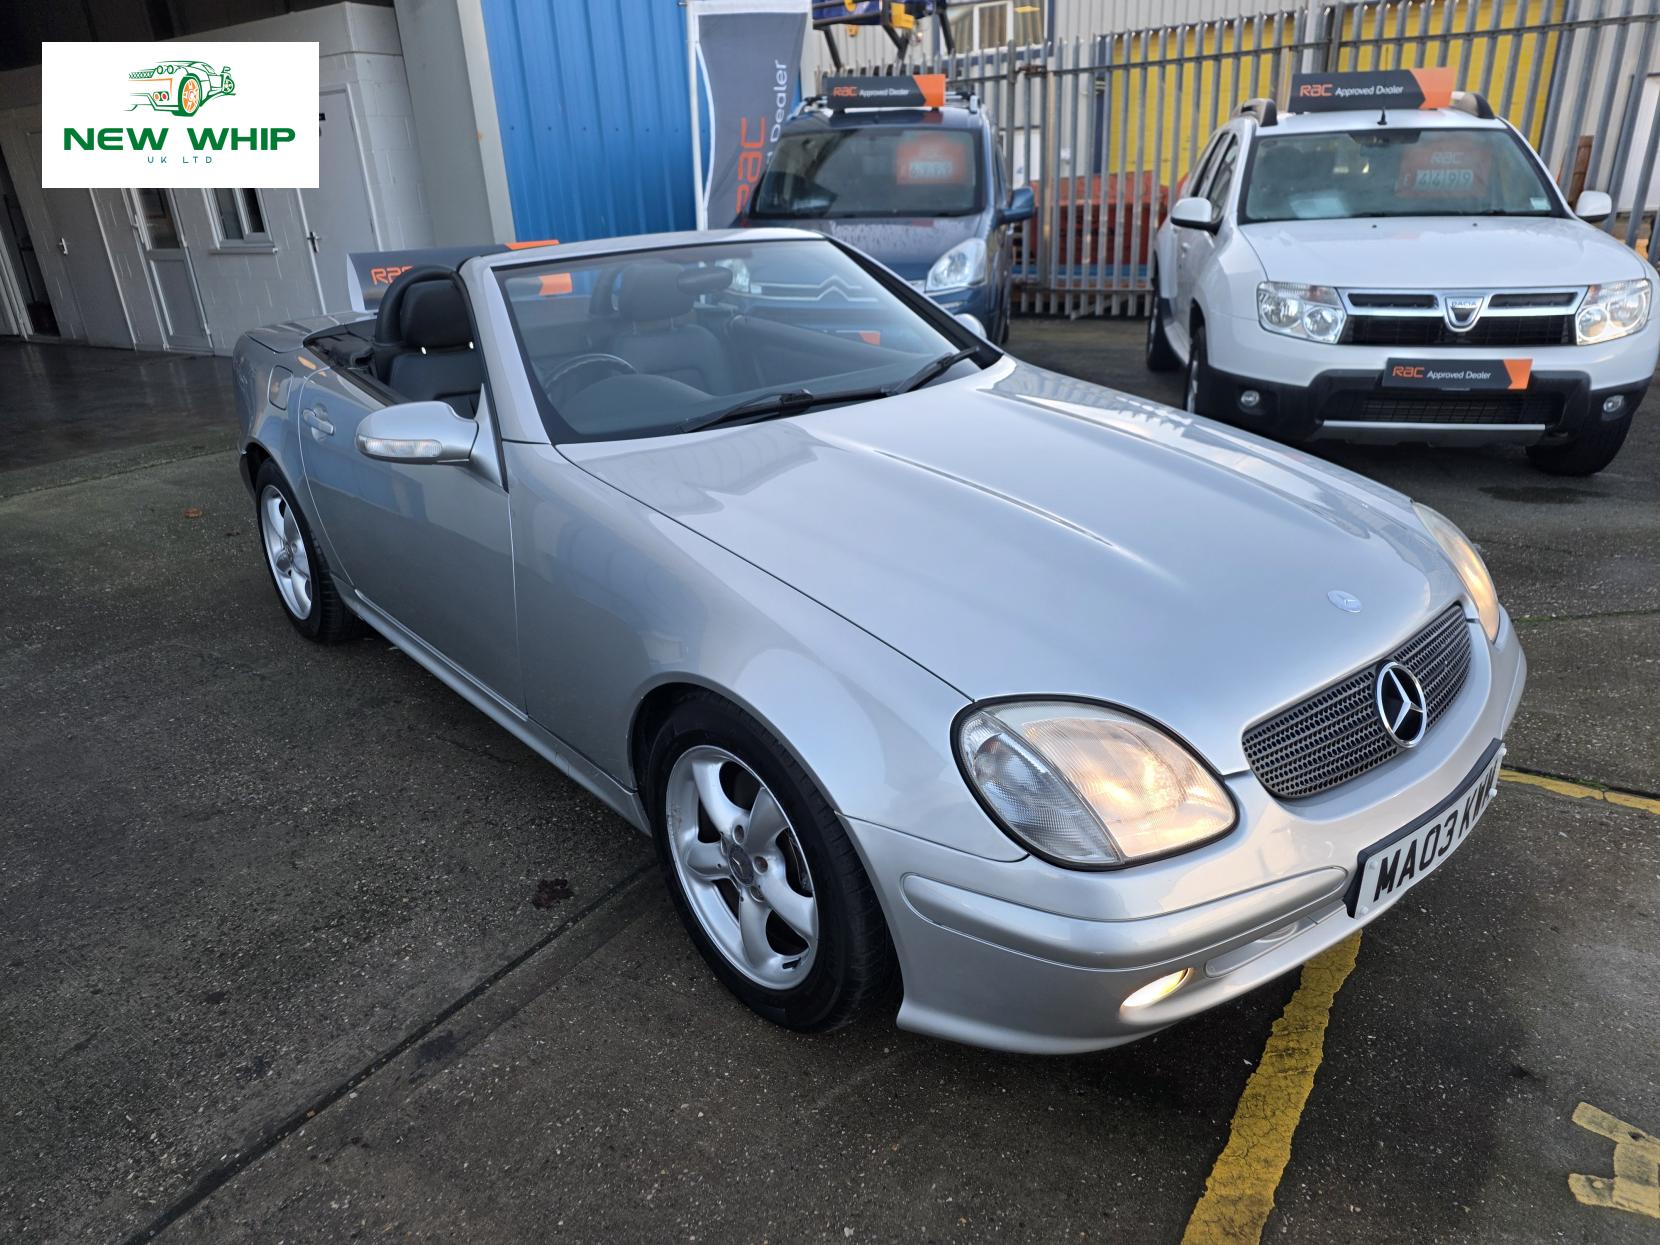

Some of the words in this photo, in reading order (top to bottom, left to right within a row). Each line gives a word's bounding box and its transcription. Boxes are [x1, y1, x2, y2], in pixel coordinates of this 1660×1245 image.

[859, 88, 888, 98] Approved
[889, 88, 910, 96] Dealer
[1335, 85, 1375, 98] Approved
[1375, 84, 1404, 95] Dealer
[770, 60, 788, 142] Dealer
[1426, 370, 1465, 380] Approved
[1465, 371, 1492, 380] Dealer
[1373, 810, 1458, 902] MA03
